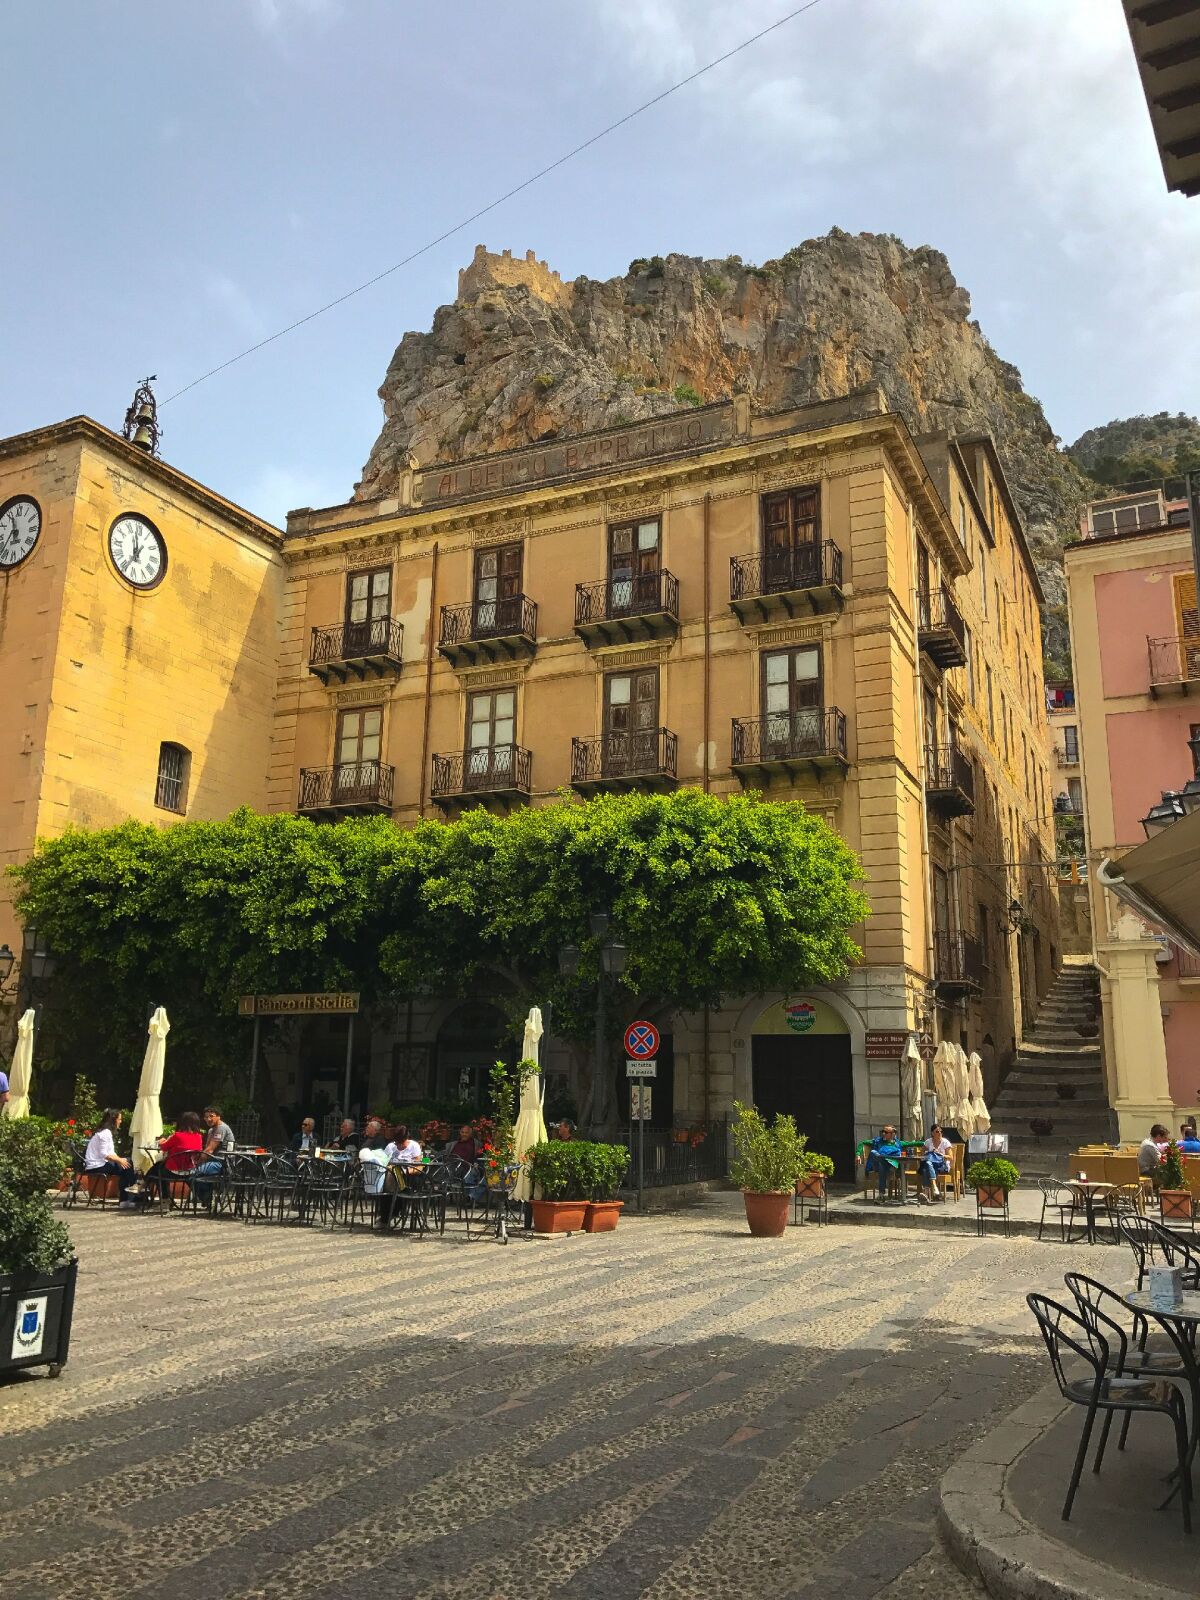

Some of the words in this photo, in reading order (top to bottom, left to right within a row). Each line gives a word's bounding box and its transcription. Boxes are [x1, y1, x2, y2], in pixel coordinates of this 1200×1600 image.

[438, 455, 547, 496] ALBERGO
[256, 997, 297, 1010] Banco
[297, 995, 311, 1009] di
[313, 994, 354, 1009] Sicilia
